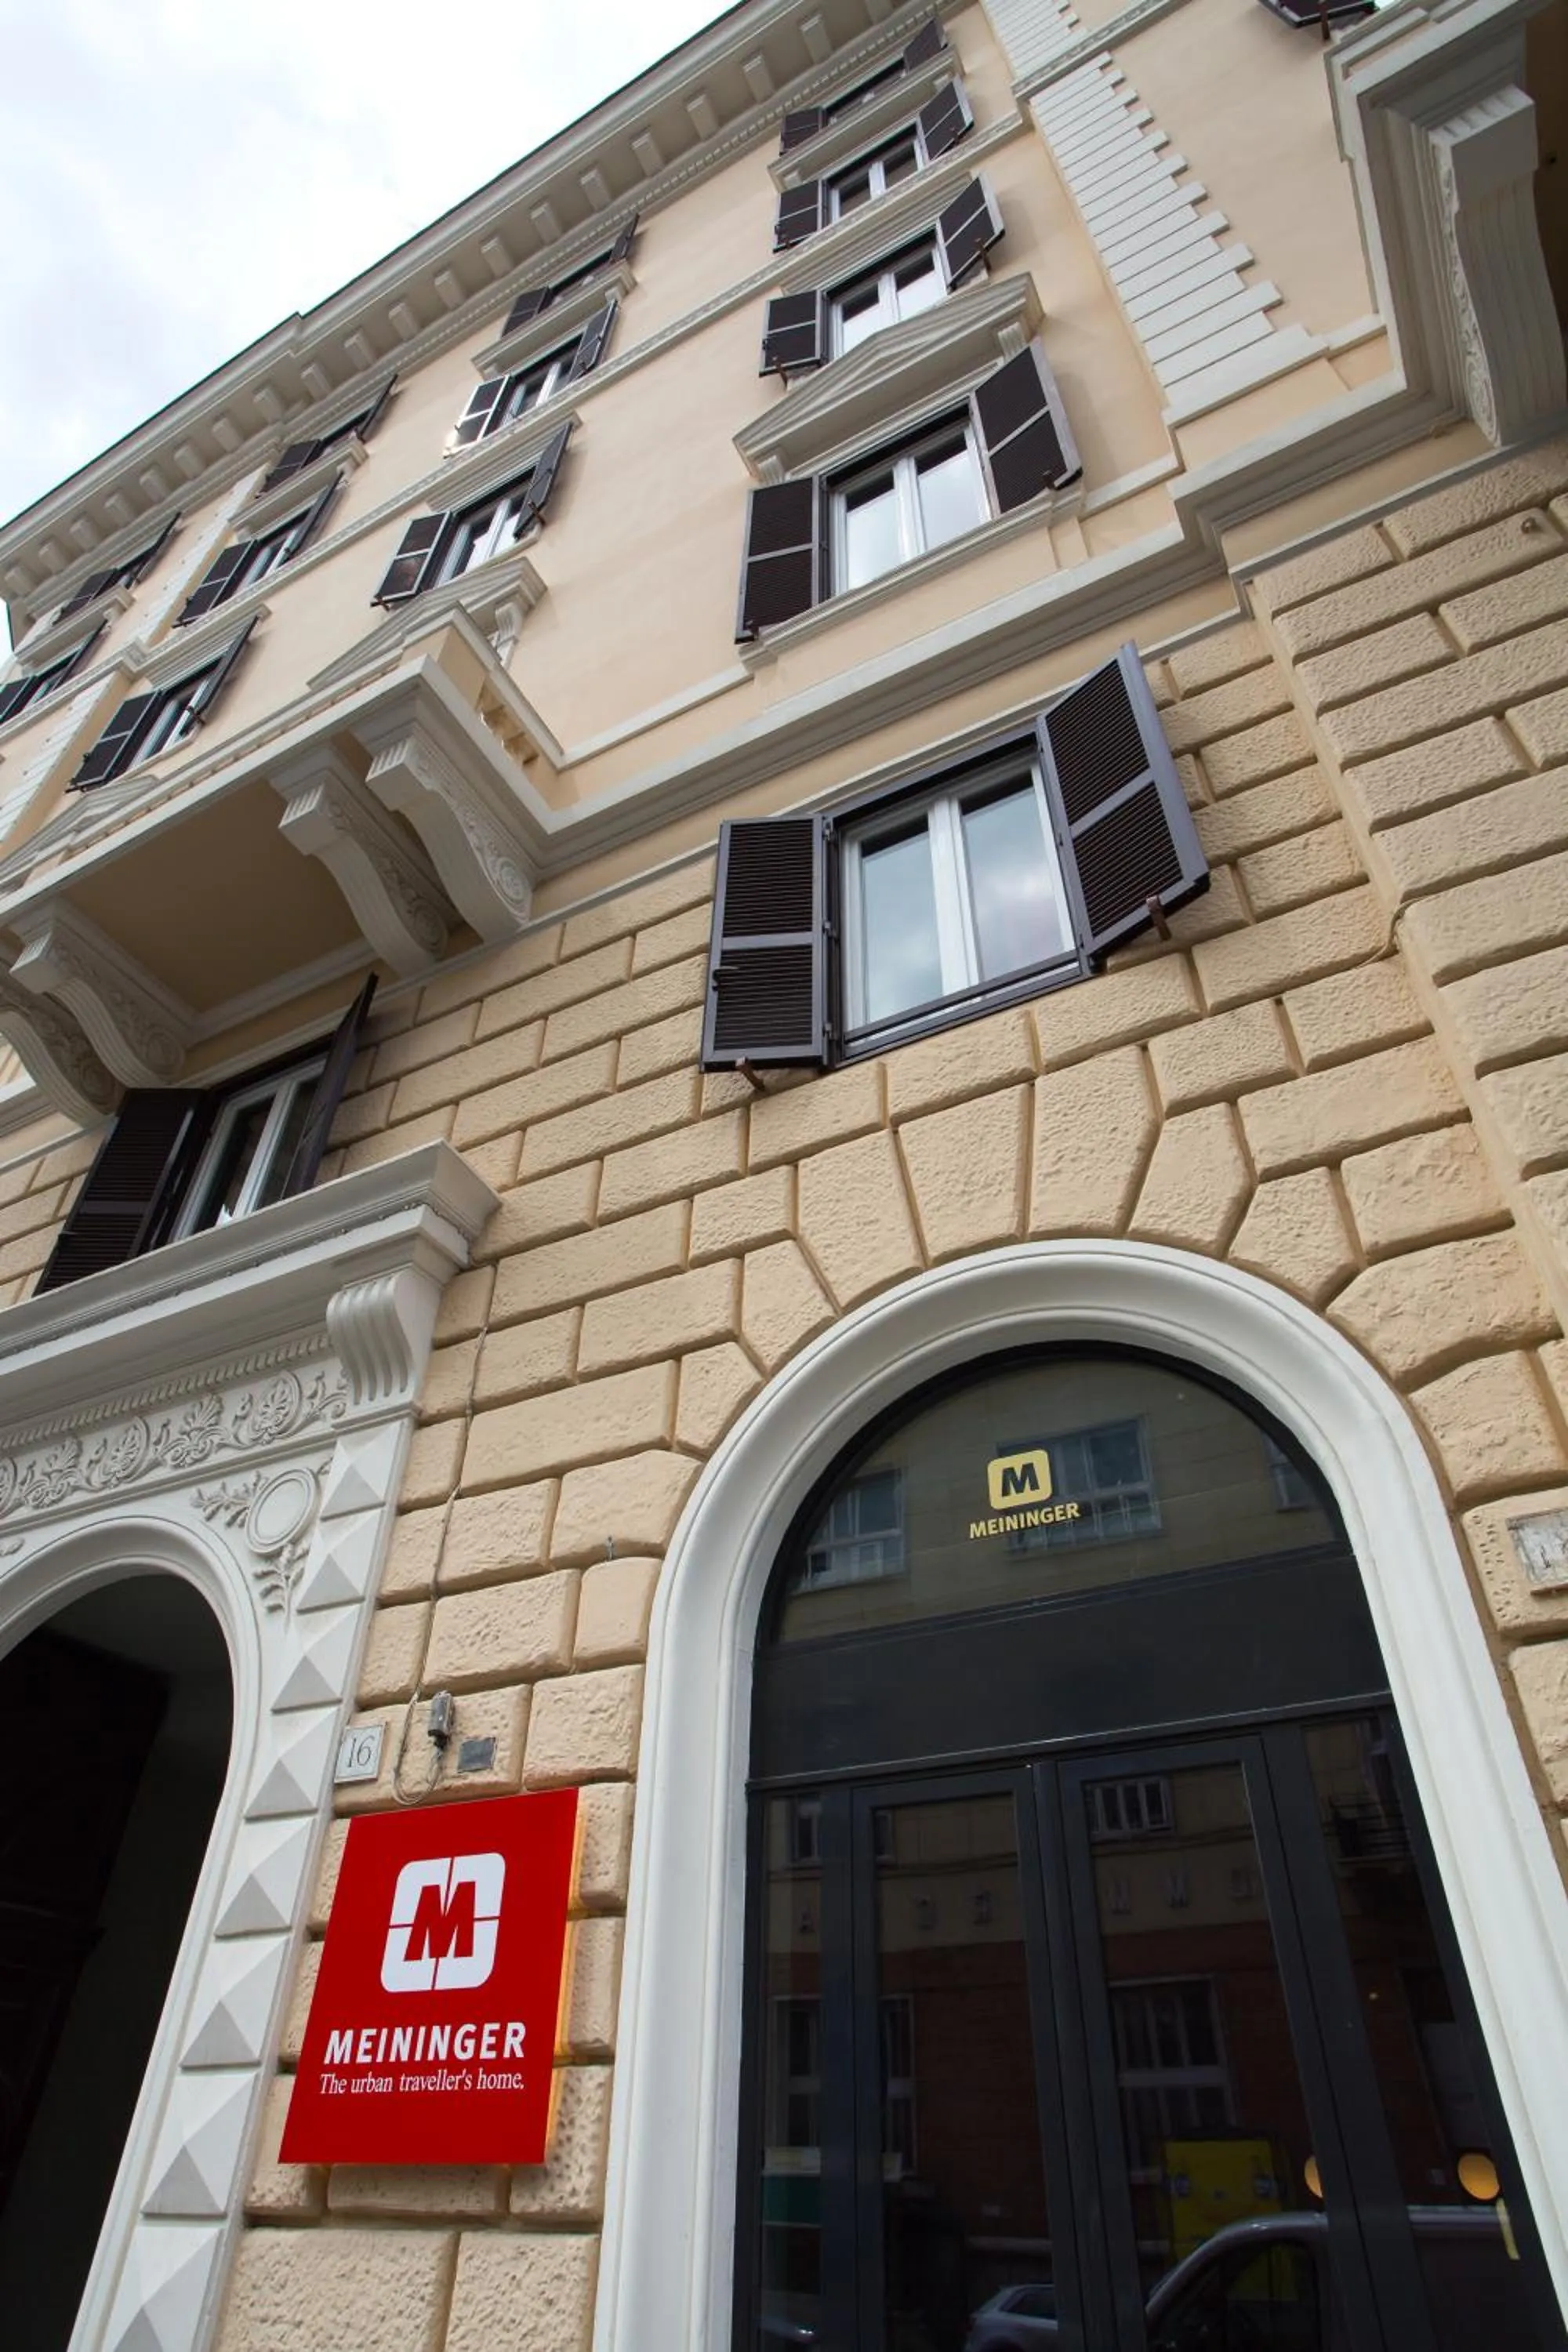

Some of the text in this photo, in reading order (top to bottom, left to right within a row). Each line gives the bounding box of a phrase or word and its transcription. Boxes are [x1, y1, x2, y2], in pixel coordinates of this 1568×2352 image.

[969, 1502, 1081, 1539] MEININGER
[347, 1734, 376, 1768] 16
[323, 2021, 526, 2065] MEININGER
[320, 2067, 524, 2094] The urban traveller's home.
